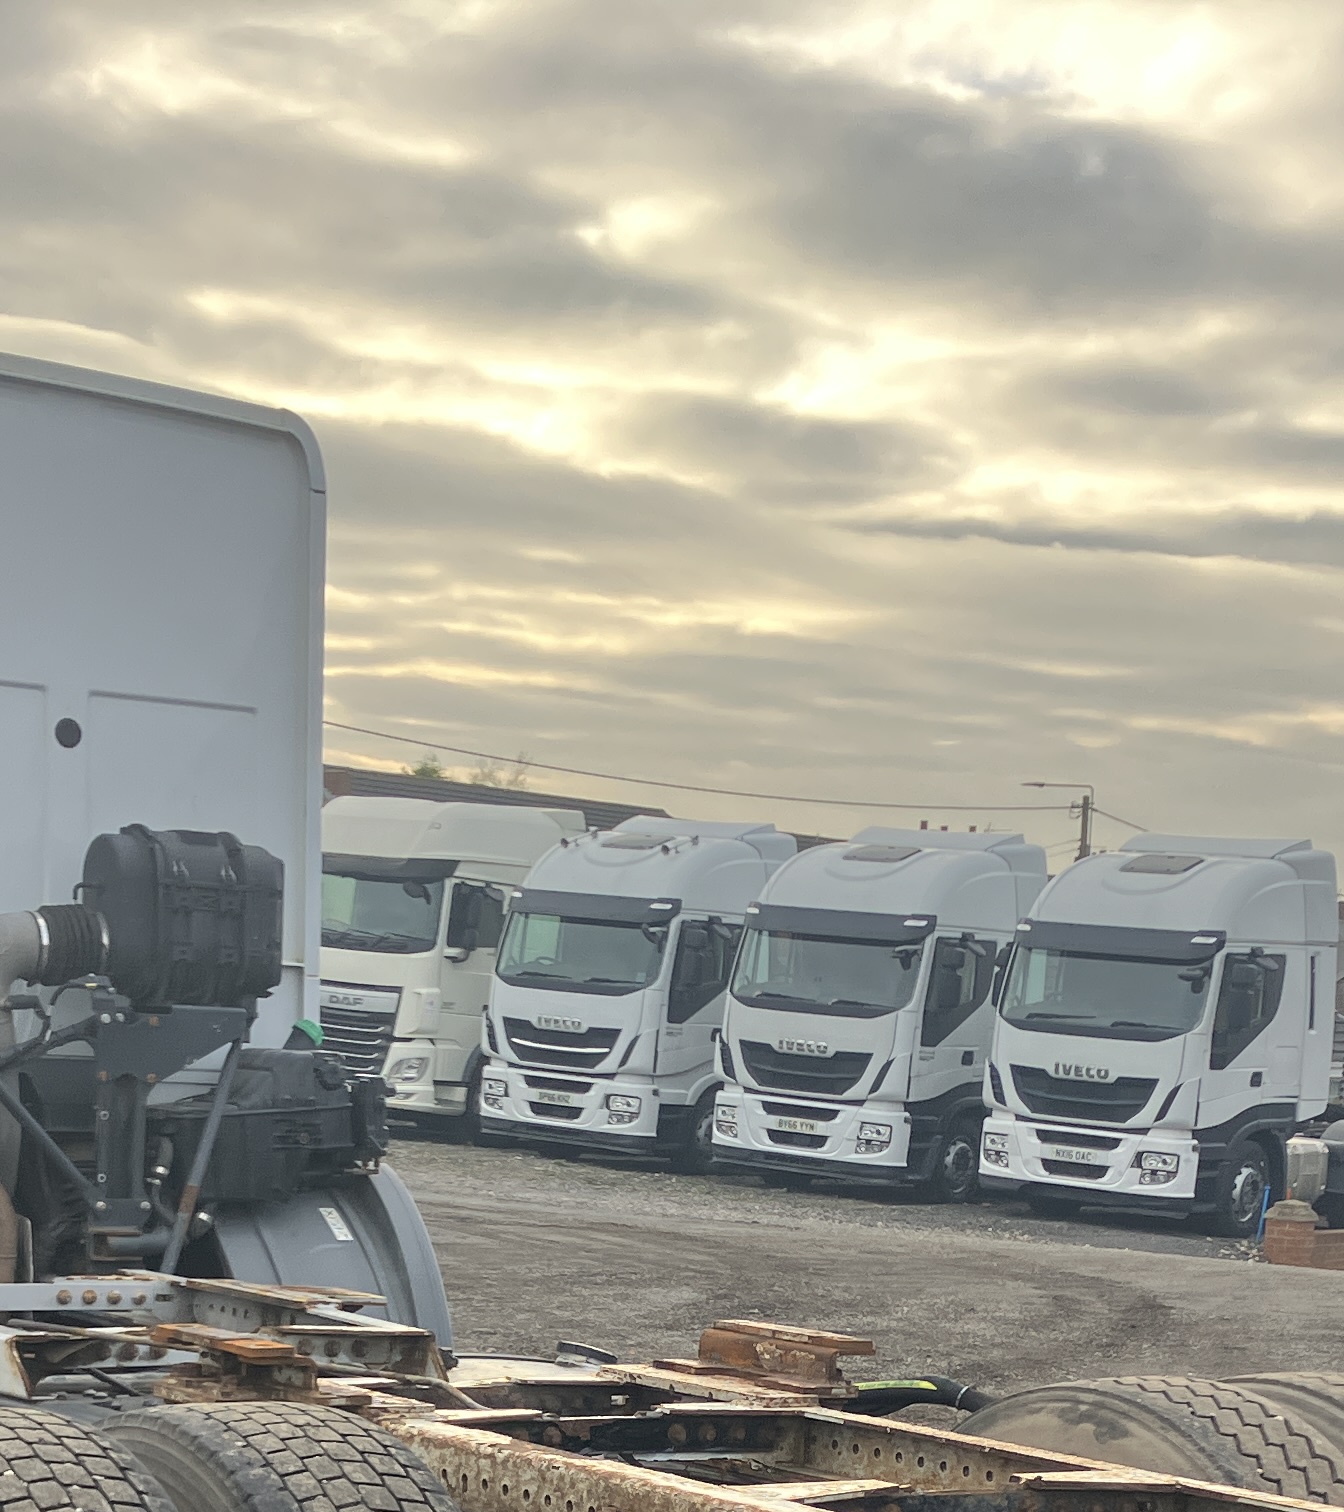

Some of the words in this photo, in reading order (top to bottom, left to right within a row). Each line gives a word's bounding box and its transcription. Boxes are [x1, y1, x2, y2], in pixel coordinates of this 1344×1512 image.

[329, 995, 364, 1006] DAF
[537, 1014, 582, 1030] IVECO
[778, 1038, 828, 1054] IVECO
[1054, 1062, 1110, 1080] IVECO
